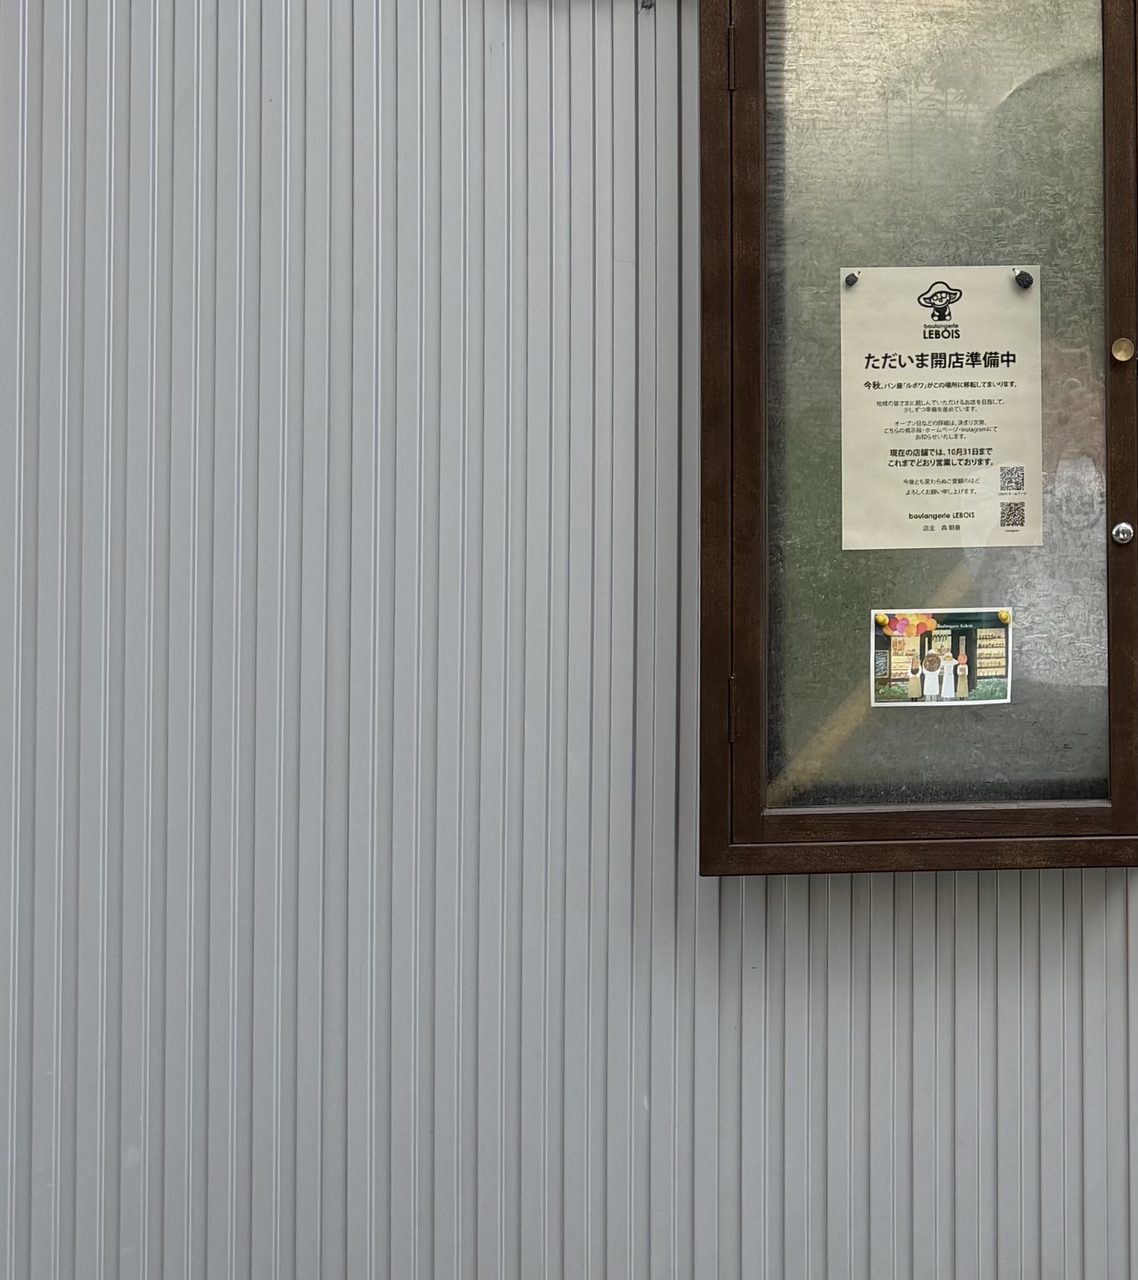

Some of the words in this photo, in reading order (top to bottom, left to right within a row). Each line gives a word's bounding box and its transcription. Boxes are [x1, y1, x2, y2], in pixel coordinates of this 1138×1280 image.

[923, 329, 961, 340] LEBOIS
[864, 351, 1017, 370] ただいま開店準備中
[889, 448, 993, 457] 現在の店舗では、10月31日まで
[887, 458, 994, 467] これまでどおり営業しております。
